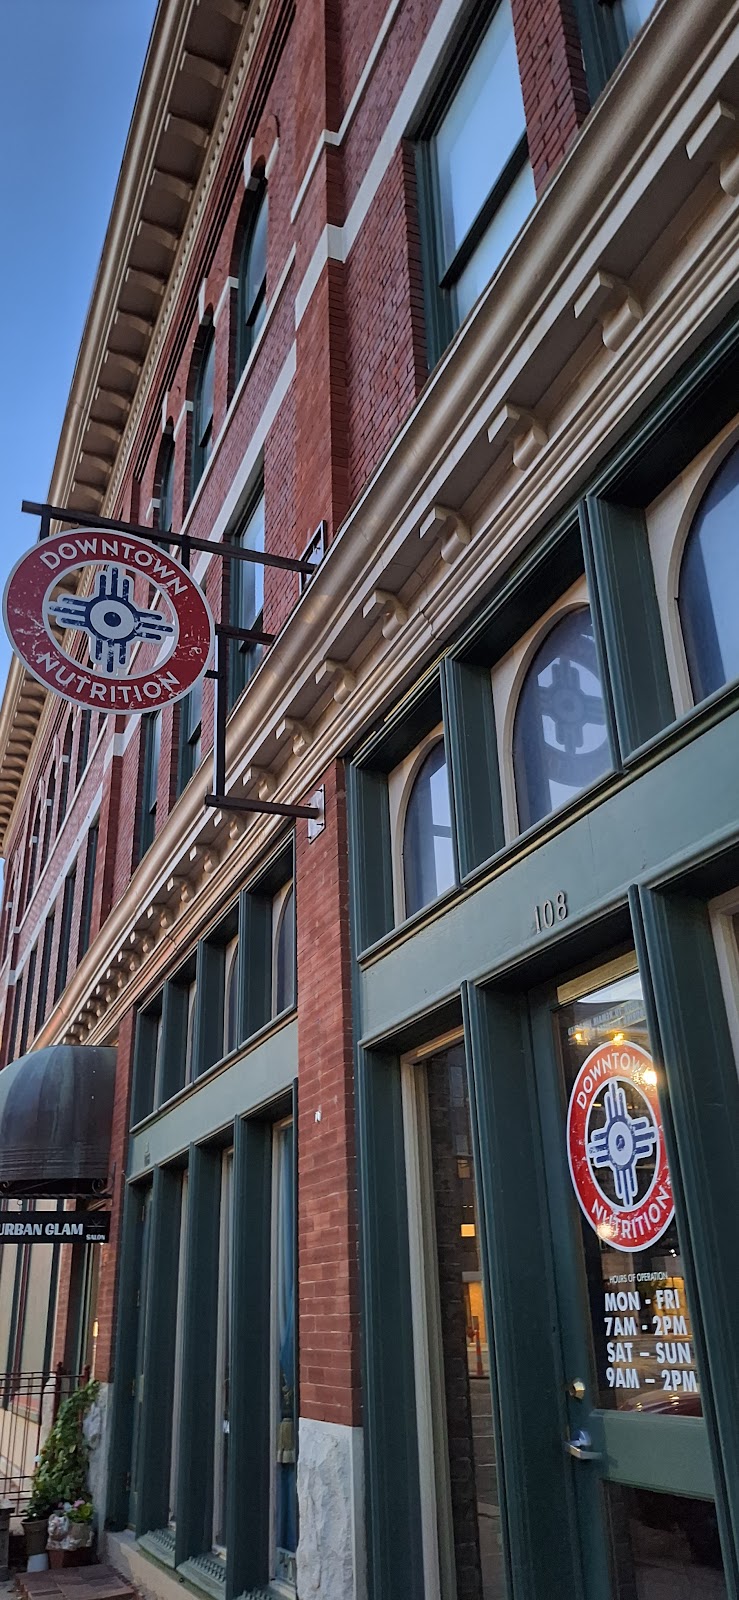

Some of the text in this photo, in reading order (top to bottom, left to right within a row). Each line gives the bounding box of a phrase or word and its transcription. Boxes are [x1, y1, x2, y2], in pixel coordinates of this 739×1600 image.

[39, 538, 188, 596] DOWNTOWN
[36, 652, 181, 703] NUTRITION
[534, 891, 567, 935] 108
[576, 1052, 654, 1109] DOWNTOW
[591, 1186, 672, 1240] NUTRITION
[44, 1223, 84, 1236] GLAM
[609, 1271, 668, 1284] HOURS OF OPERATION
[604, 1291, 641, 1312] MON
[655, 1288, 680, 1310] FRI
[604, 1316, 637, 1337] 7AM
[652, 1315, 688, 1336] 2PM
[606, 1342, 633, 1363] SAT
[655, 1342, 691, 1364] SUN
[606, 1367, 640, 1389] 9AM
[661, 1369, 698, 1392] 2PM
